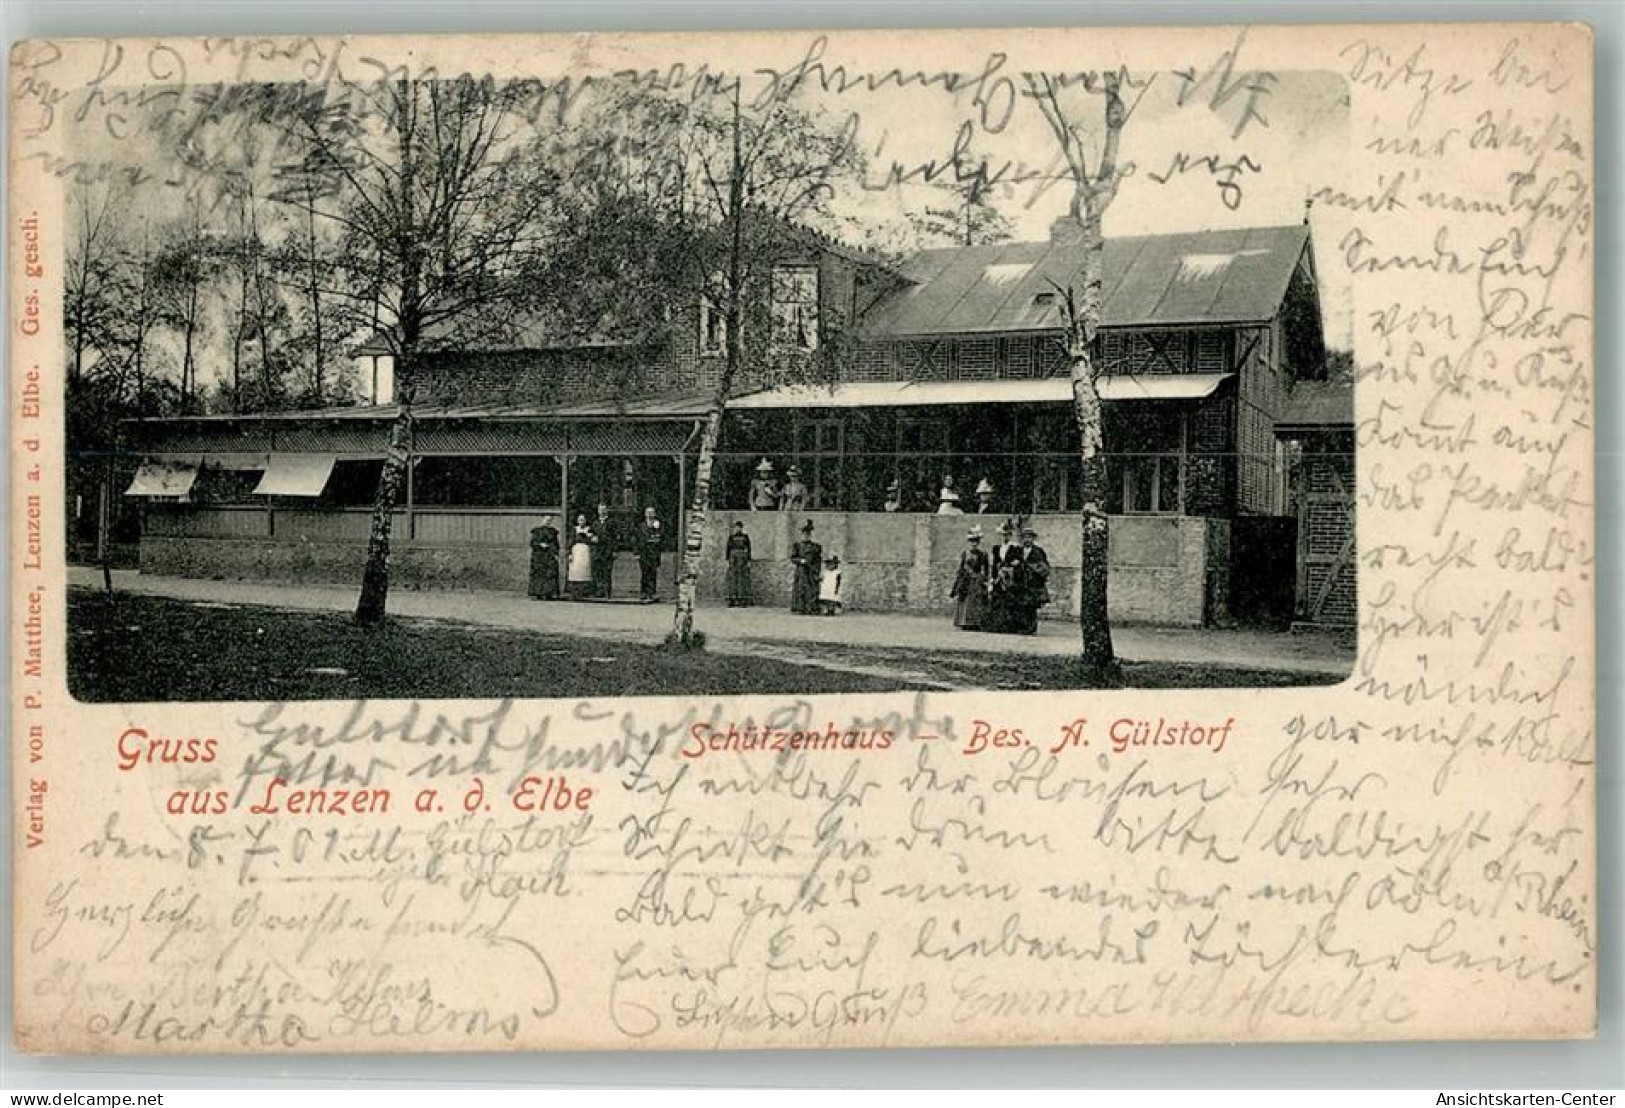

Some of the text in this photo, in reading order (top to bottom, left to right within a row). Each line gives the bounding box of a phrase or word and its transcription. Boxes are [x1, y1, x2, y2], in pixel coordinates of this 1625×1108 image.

[20, 209, 44, 279] gesch.
[20, 288, 41, 337] Ges.
[21, 364, 41, 420] Elbe.
[26, 463, 42, 483] a.
[22, 495, 42, 570] Lenzen
[24, 584, 46, 679] Matthee,
[24, 690, 42, 710] P.
[29, 725, 42, 764] von
[115, 725, 220, 773] Gruss
[682, 720, 895, 759] Schützenhaus
[962, 718, 1032, 756] Bes.
[1107, 716, 1237, 756] Gülstorf
[24, 778, 47, 849] Verlag
[164, 775, 595, 818] aus Lenzen a. d. Elbe
